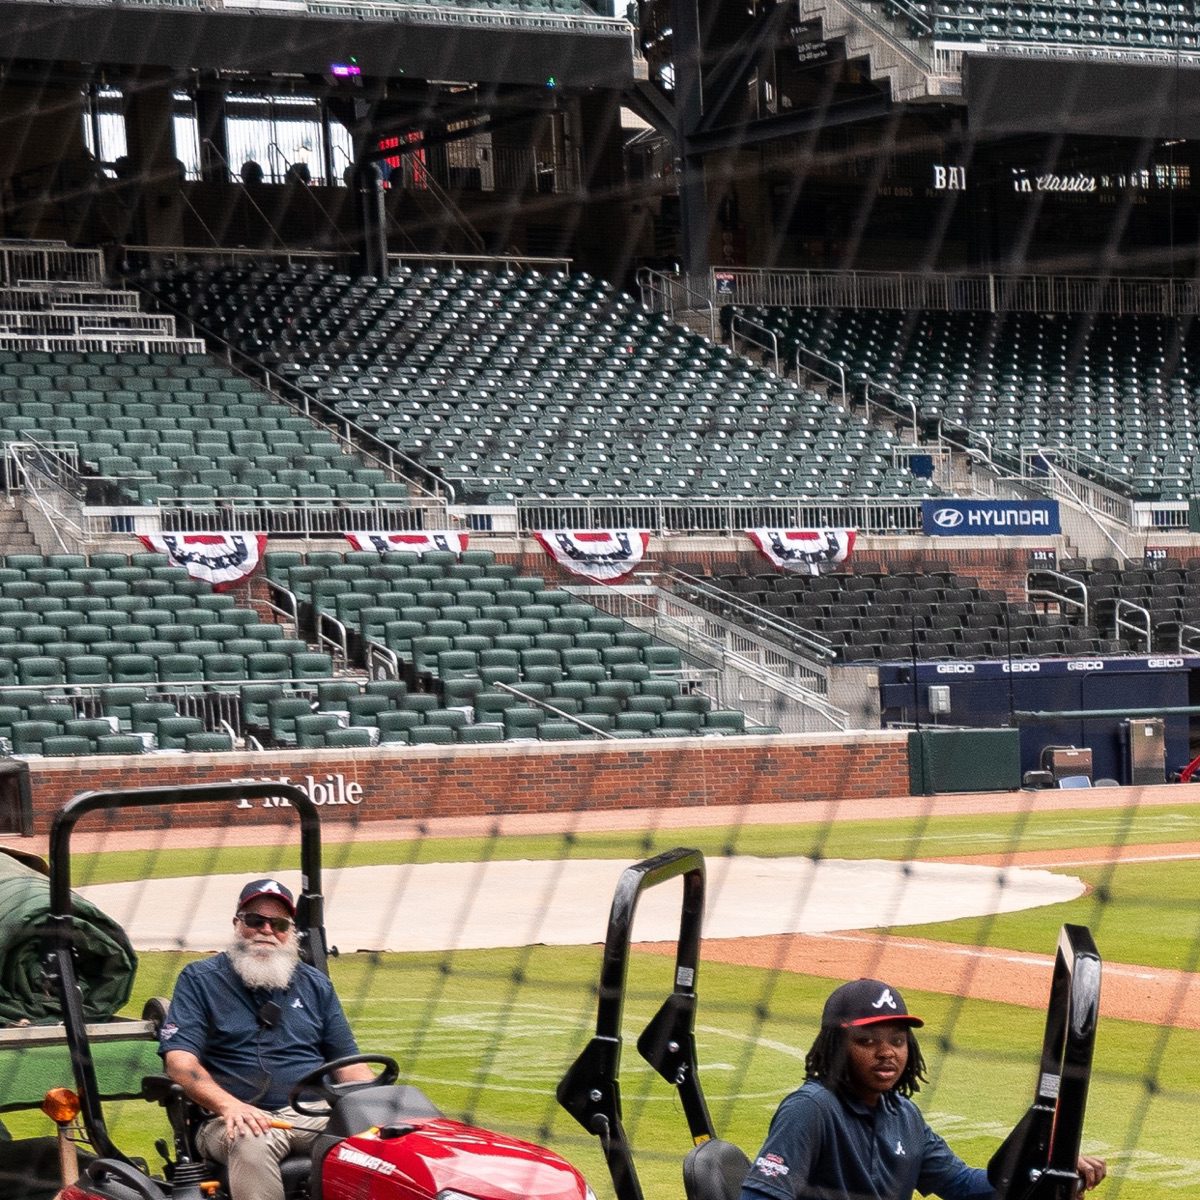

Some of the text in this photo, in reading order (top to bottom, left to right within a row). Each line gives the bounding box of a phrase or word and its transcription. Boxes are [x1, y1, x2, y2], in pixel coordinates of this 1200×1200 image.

[968, 509, 1049, 526] HYUNDAI
[1002, 663, 1040, 672] GEICO
[1067, 661, 1104, 671] GEICO
[1148, 658, 1184, 668] GEICO
[937, 664, 974, 674] GEICO
